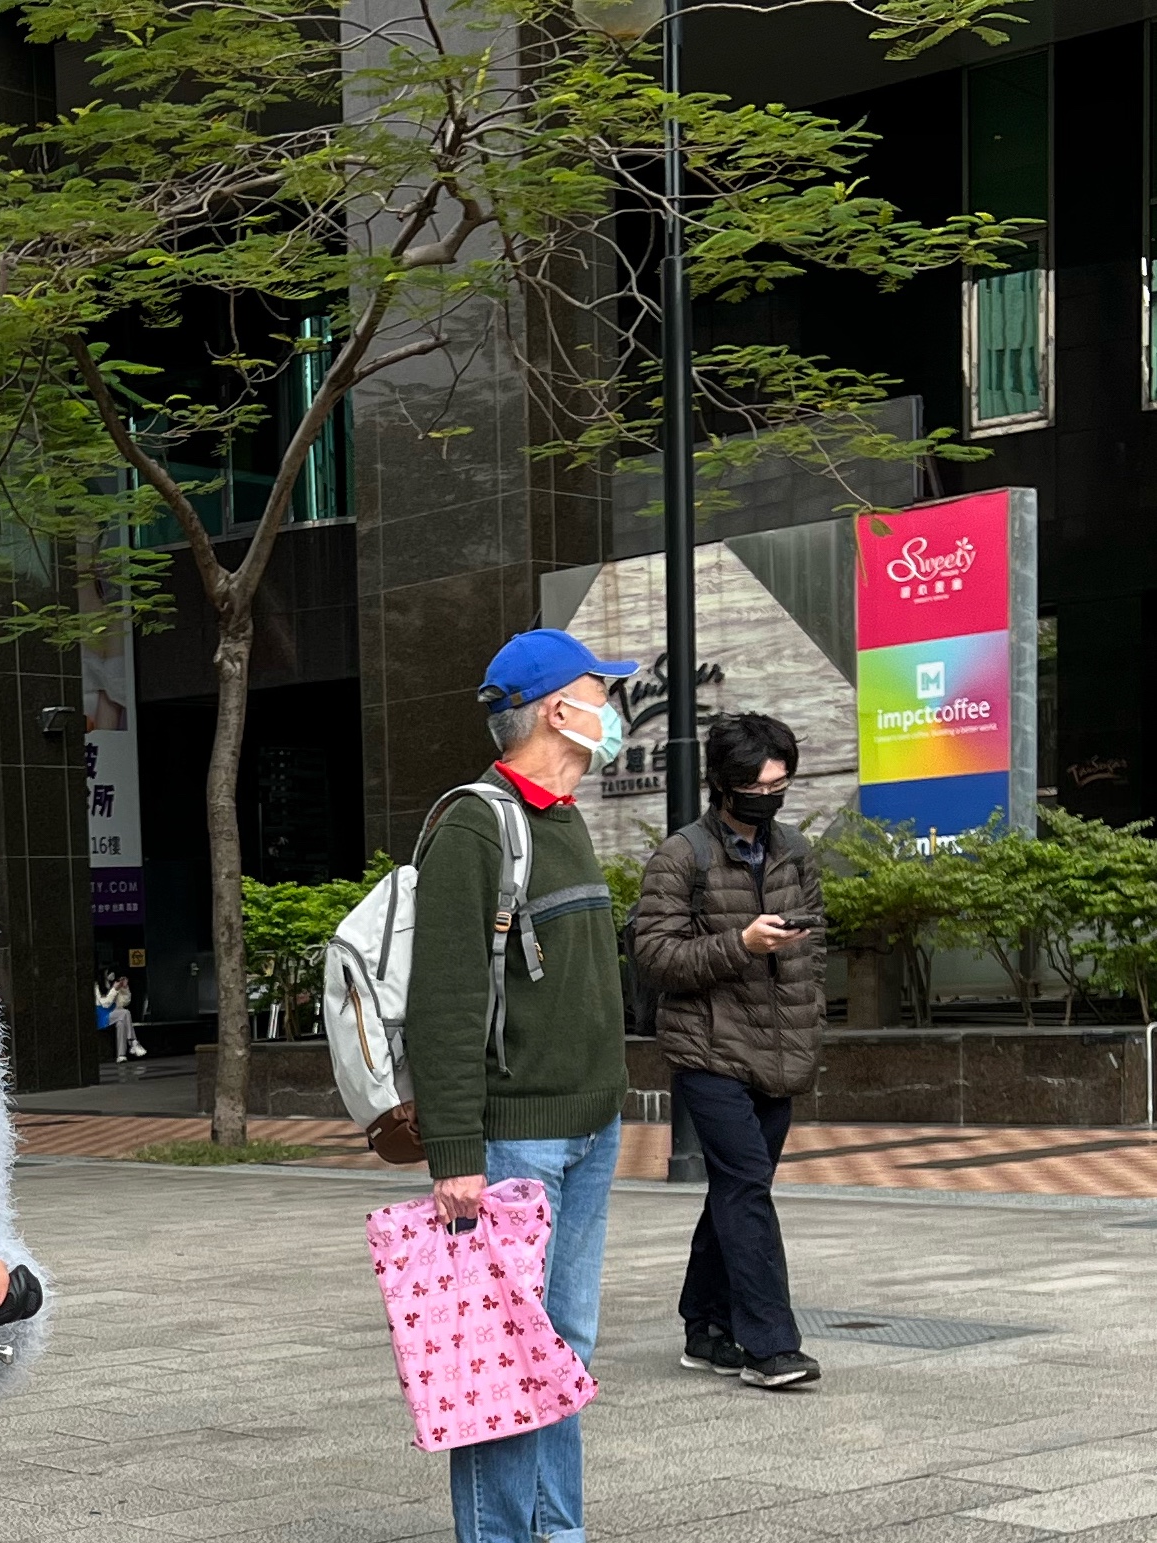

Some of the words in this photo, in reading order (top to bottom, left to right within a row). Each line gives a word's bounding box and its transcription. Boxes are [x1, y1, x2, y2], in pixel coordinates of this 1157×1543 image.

[886, 536, 977, 583] Sweety
[876, 697, 991, 733] impctcoffee
[600, 776, 661, 793] TAISUGAR
